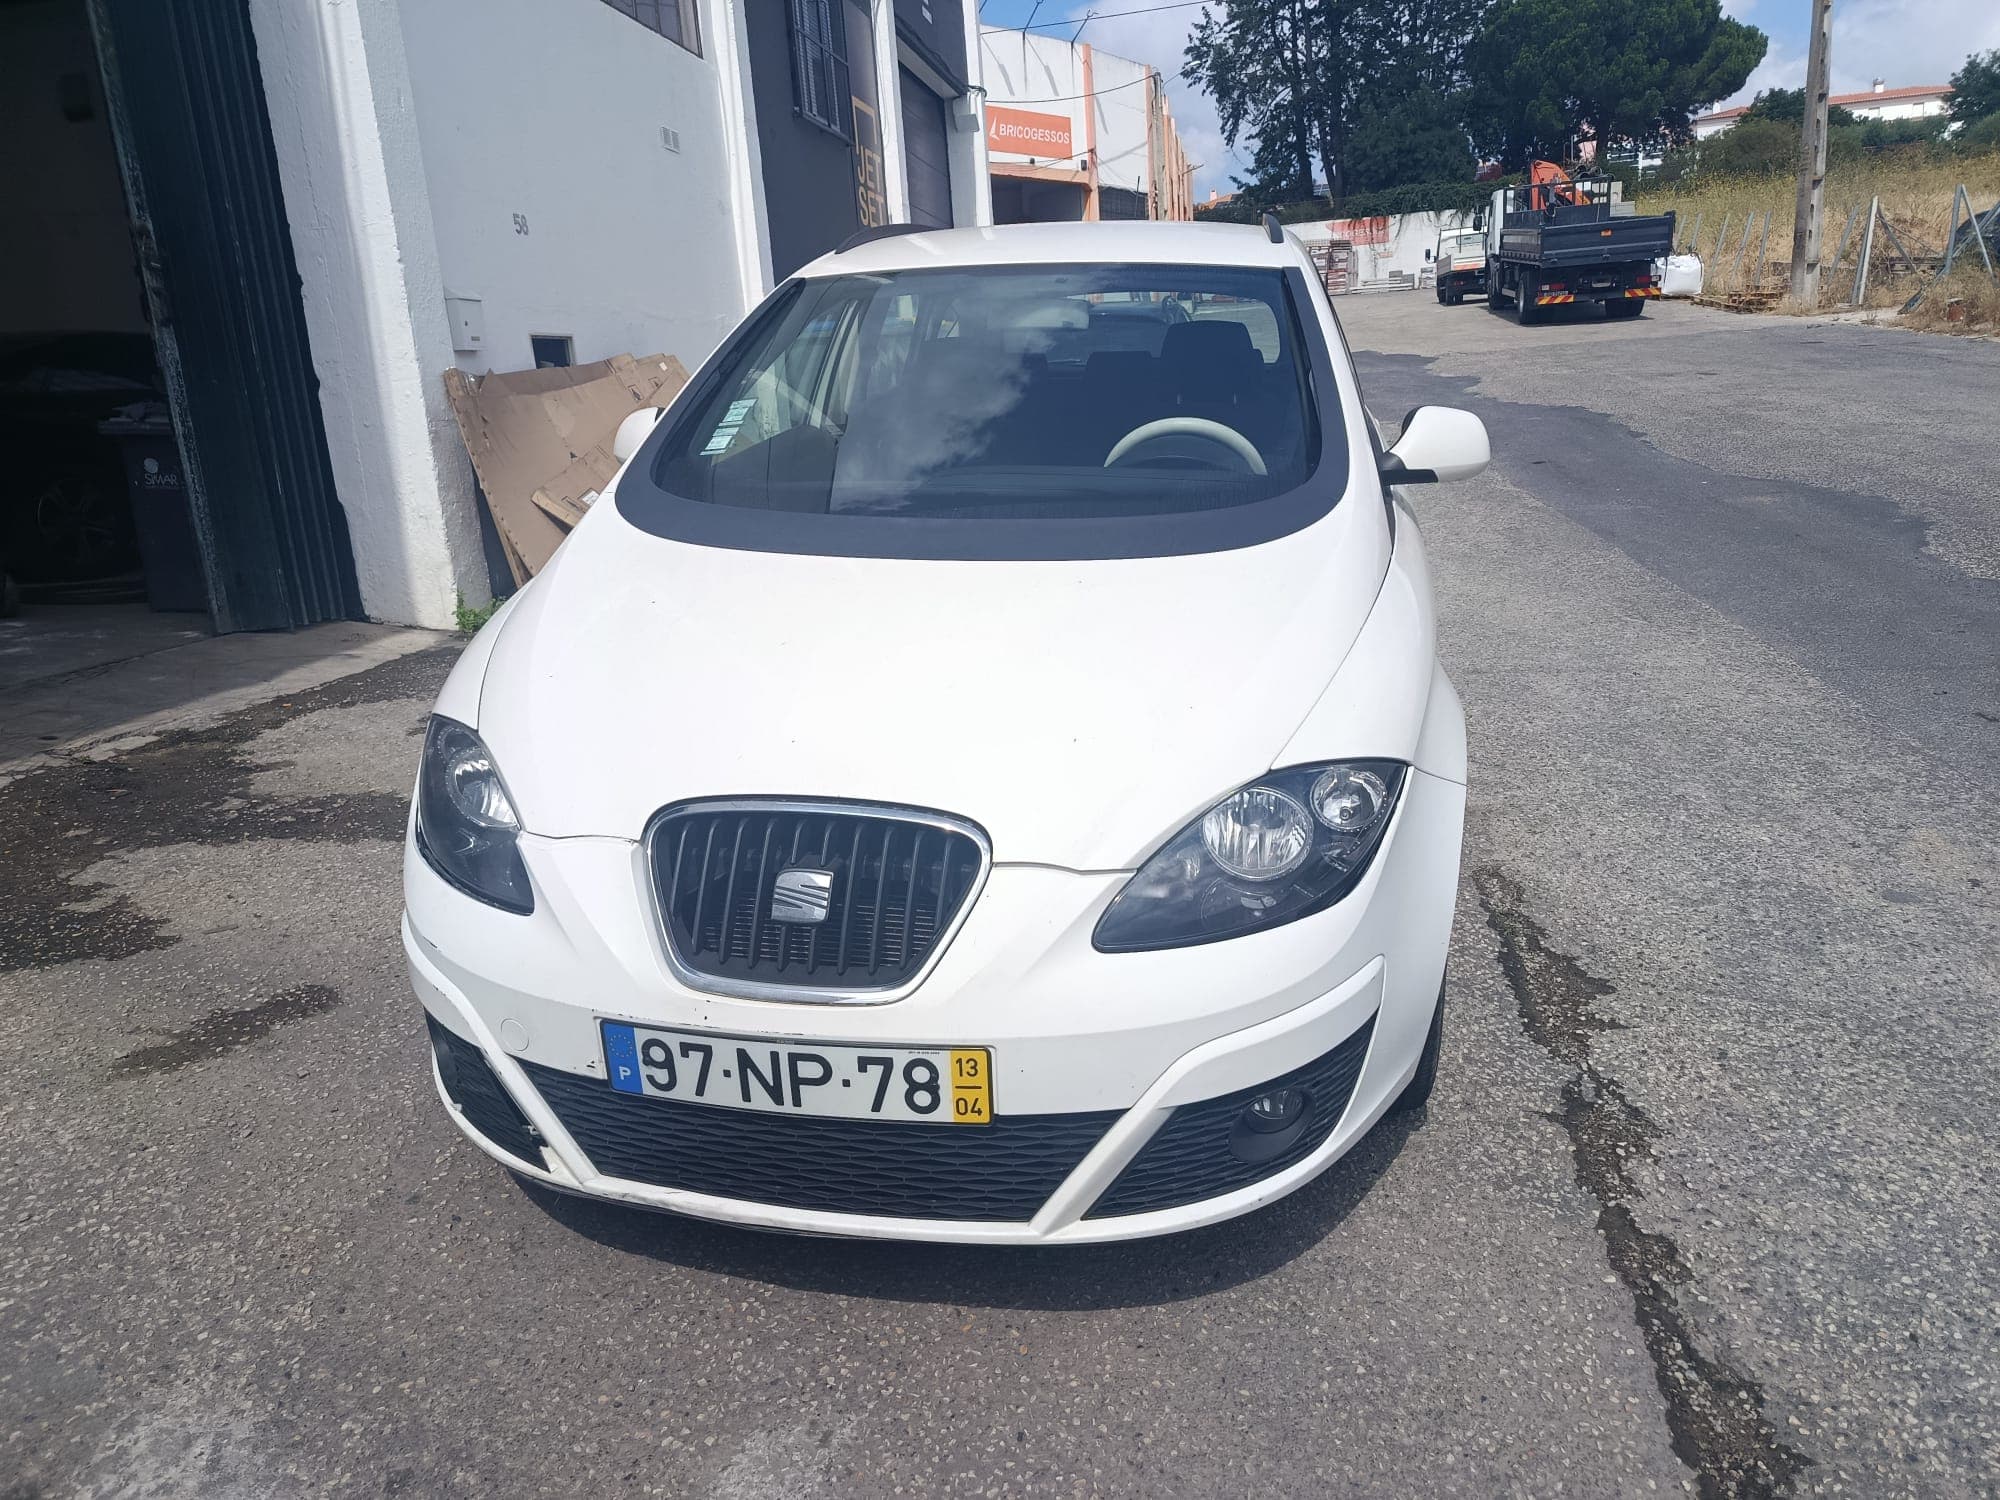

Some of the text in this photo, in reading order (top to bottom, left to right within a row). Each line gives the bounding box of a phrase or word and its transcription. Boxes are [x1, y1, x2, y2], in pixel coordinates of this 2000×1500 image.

[999, 123, 1070, 145] BRICOGESSOS
[858, 145, 880, 193] JET
[859, 186, 884, 229] SET
[513, 213, 529, 236] 58
[618, 1066, 632, 1081] P
[955, 1057, 979, 1078] 13
[955, 1097, 983, 1117] 04
